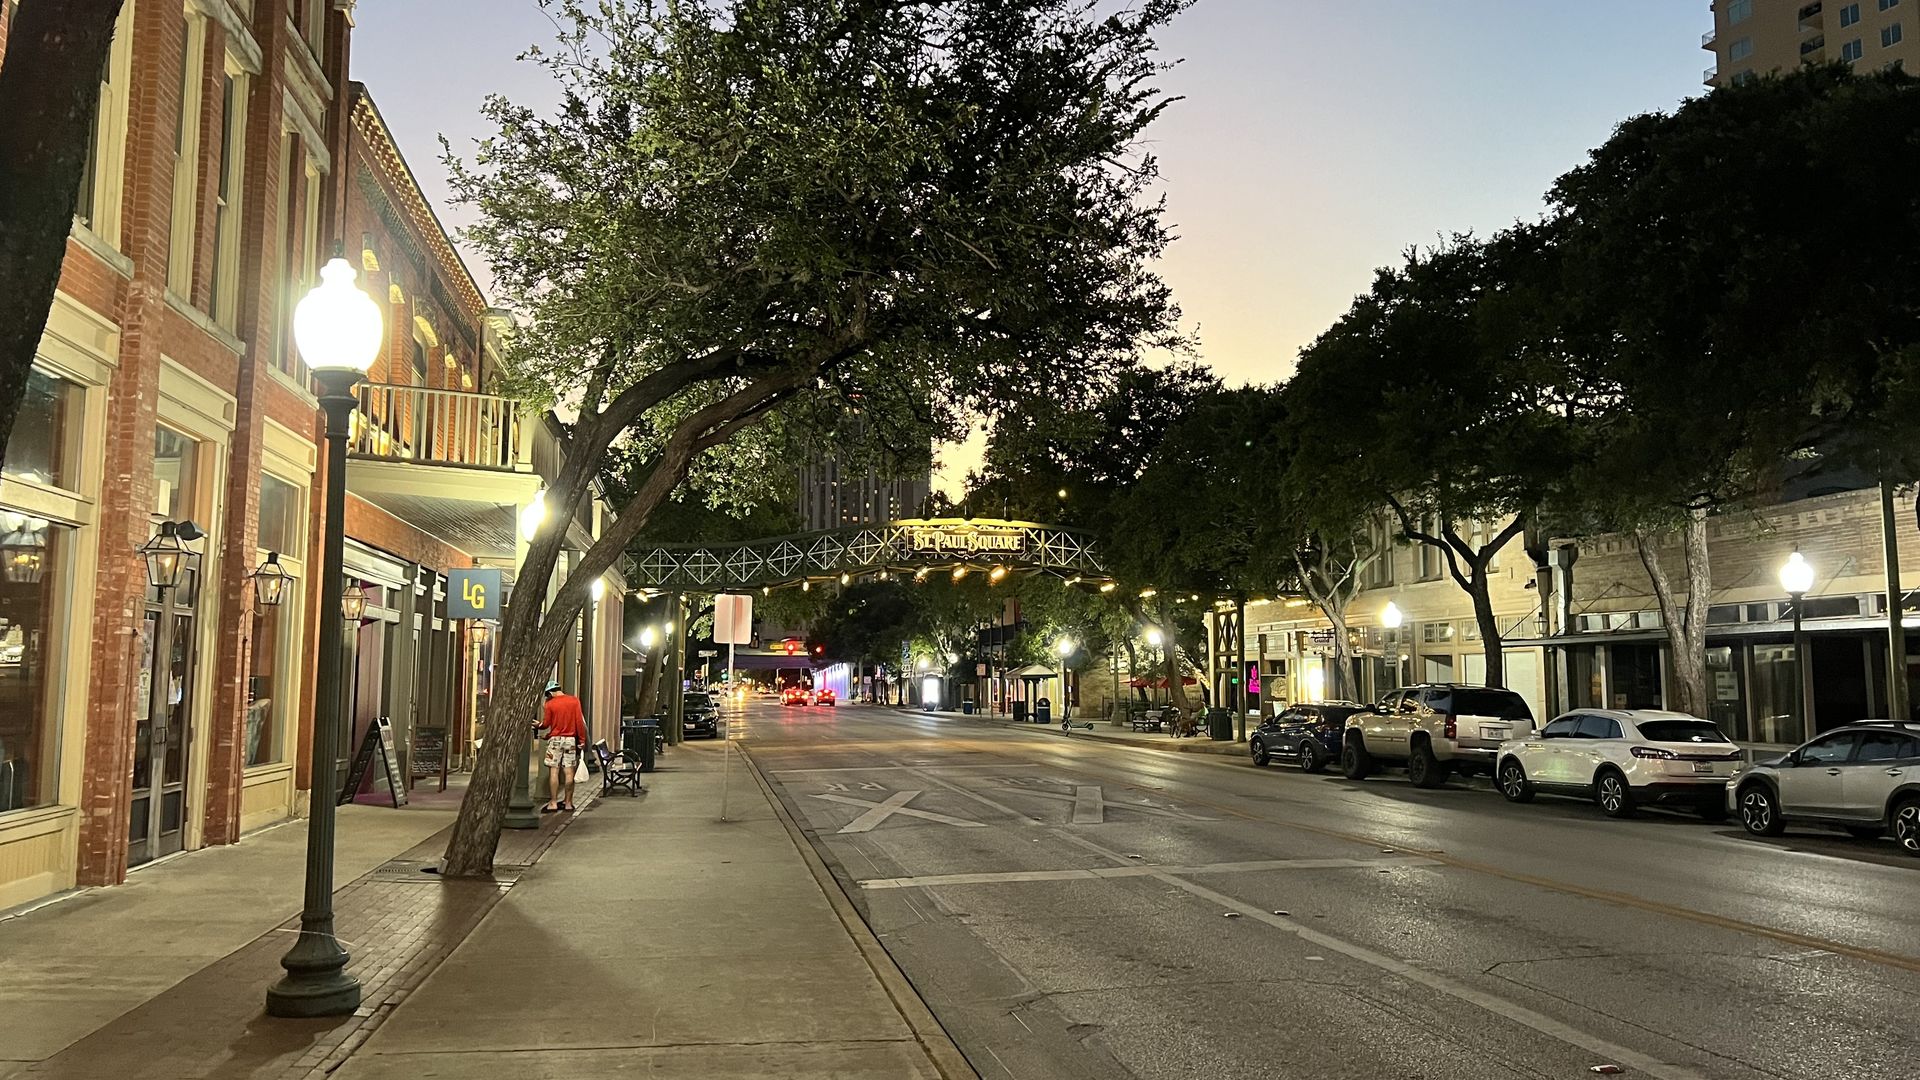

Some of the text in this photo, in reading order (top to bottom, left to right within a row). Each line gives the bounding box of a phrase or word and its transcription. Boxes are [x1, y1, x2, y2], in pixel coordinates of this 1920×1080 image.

[932, 530, 968, 553] PAUL
[968, 531, 1021, 551] SQUARE
[463, 578, 485, 609] LG
